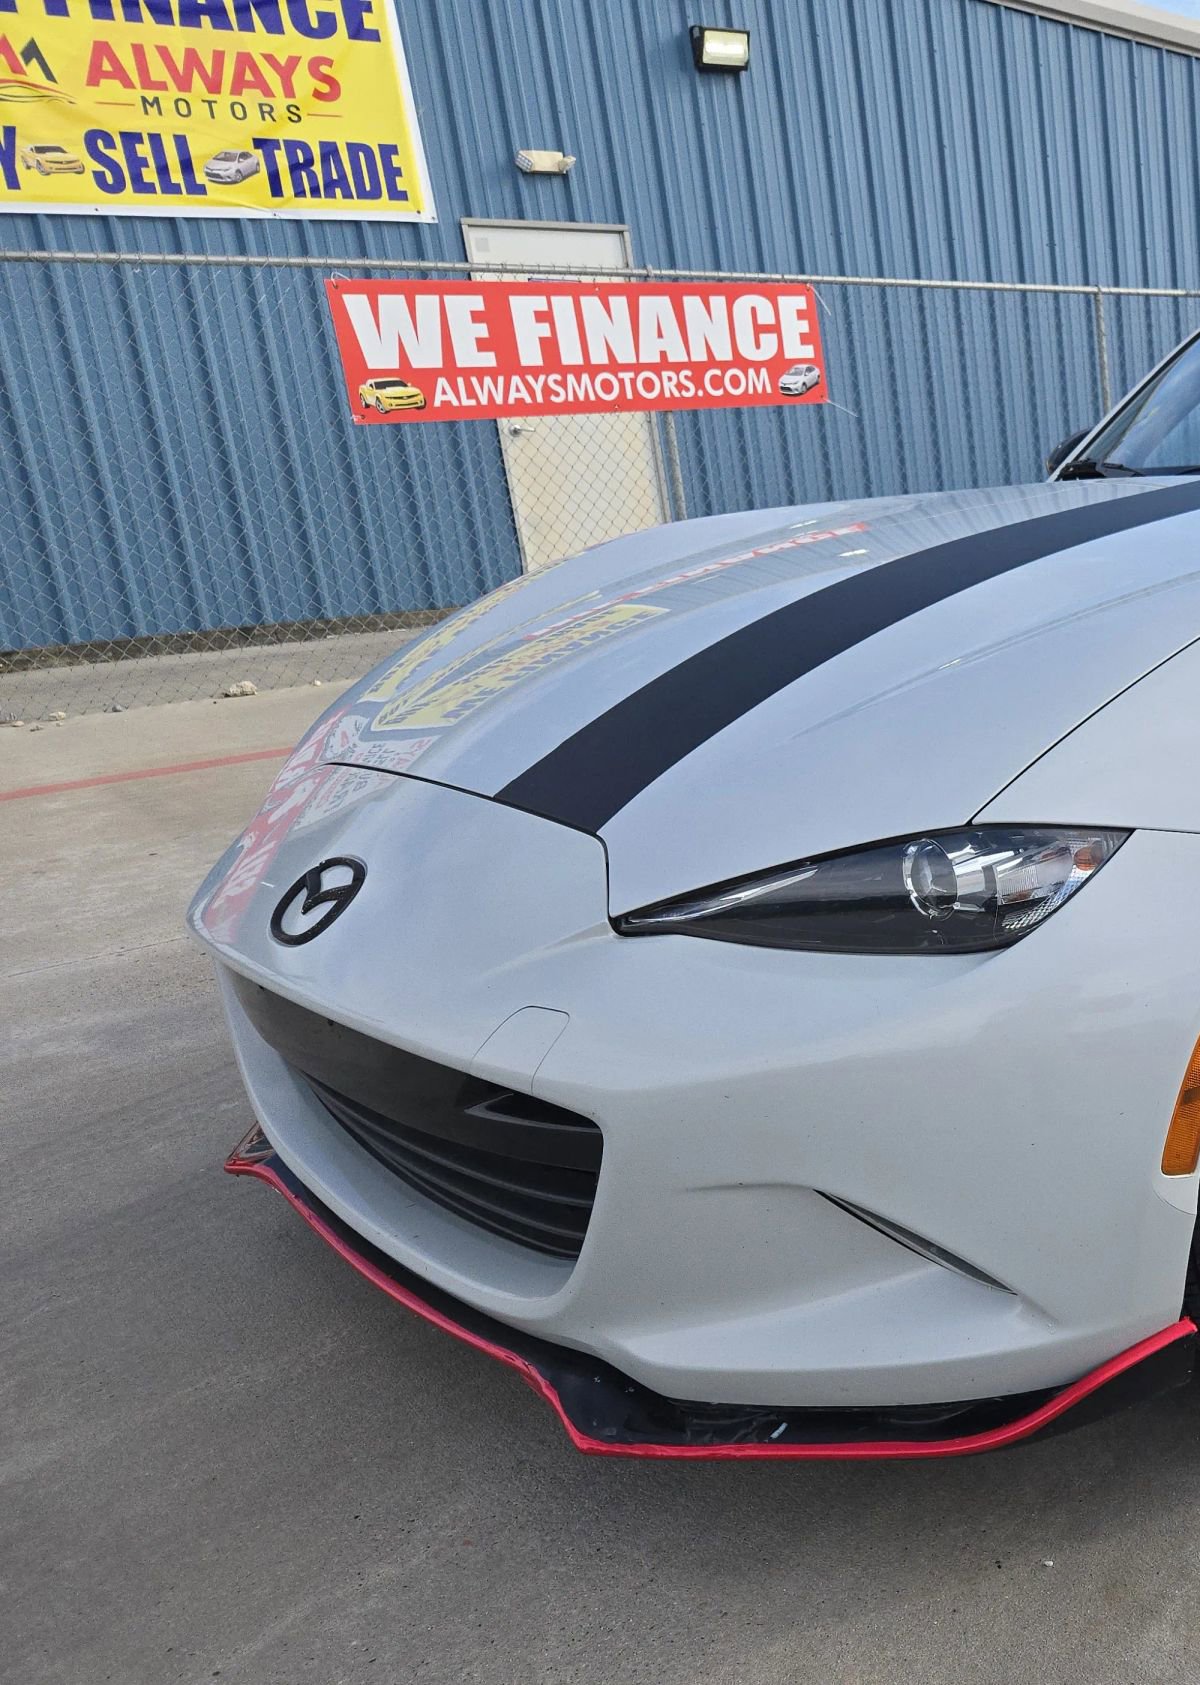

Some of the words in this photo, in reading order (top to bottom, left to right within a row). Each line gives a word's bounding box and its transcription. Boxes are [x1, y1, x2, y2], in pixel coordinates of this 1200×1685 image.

[44, 0, 381, 42] ANCE
[86, 40, 342, 102] ALWAYS
[140, 96, 303, 124] MOTORS
[83, 128, 208, 196] SELL
[252, 137, 409, 202] TRADE
[342, 293, 497, 370] WE
[508, 293, 815, 366] FINANCE
[433, 366, 772, 408] ALWAYSMOTORS.COM
